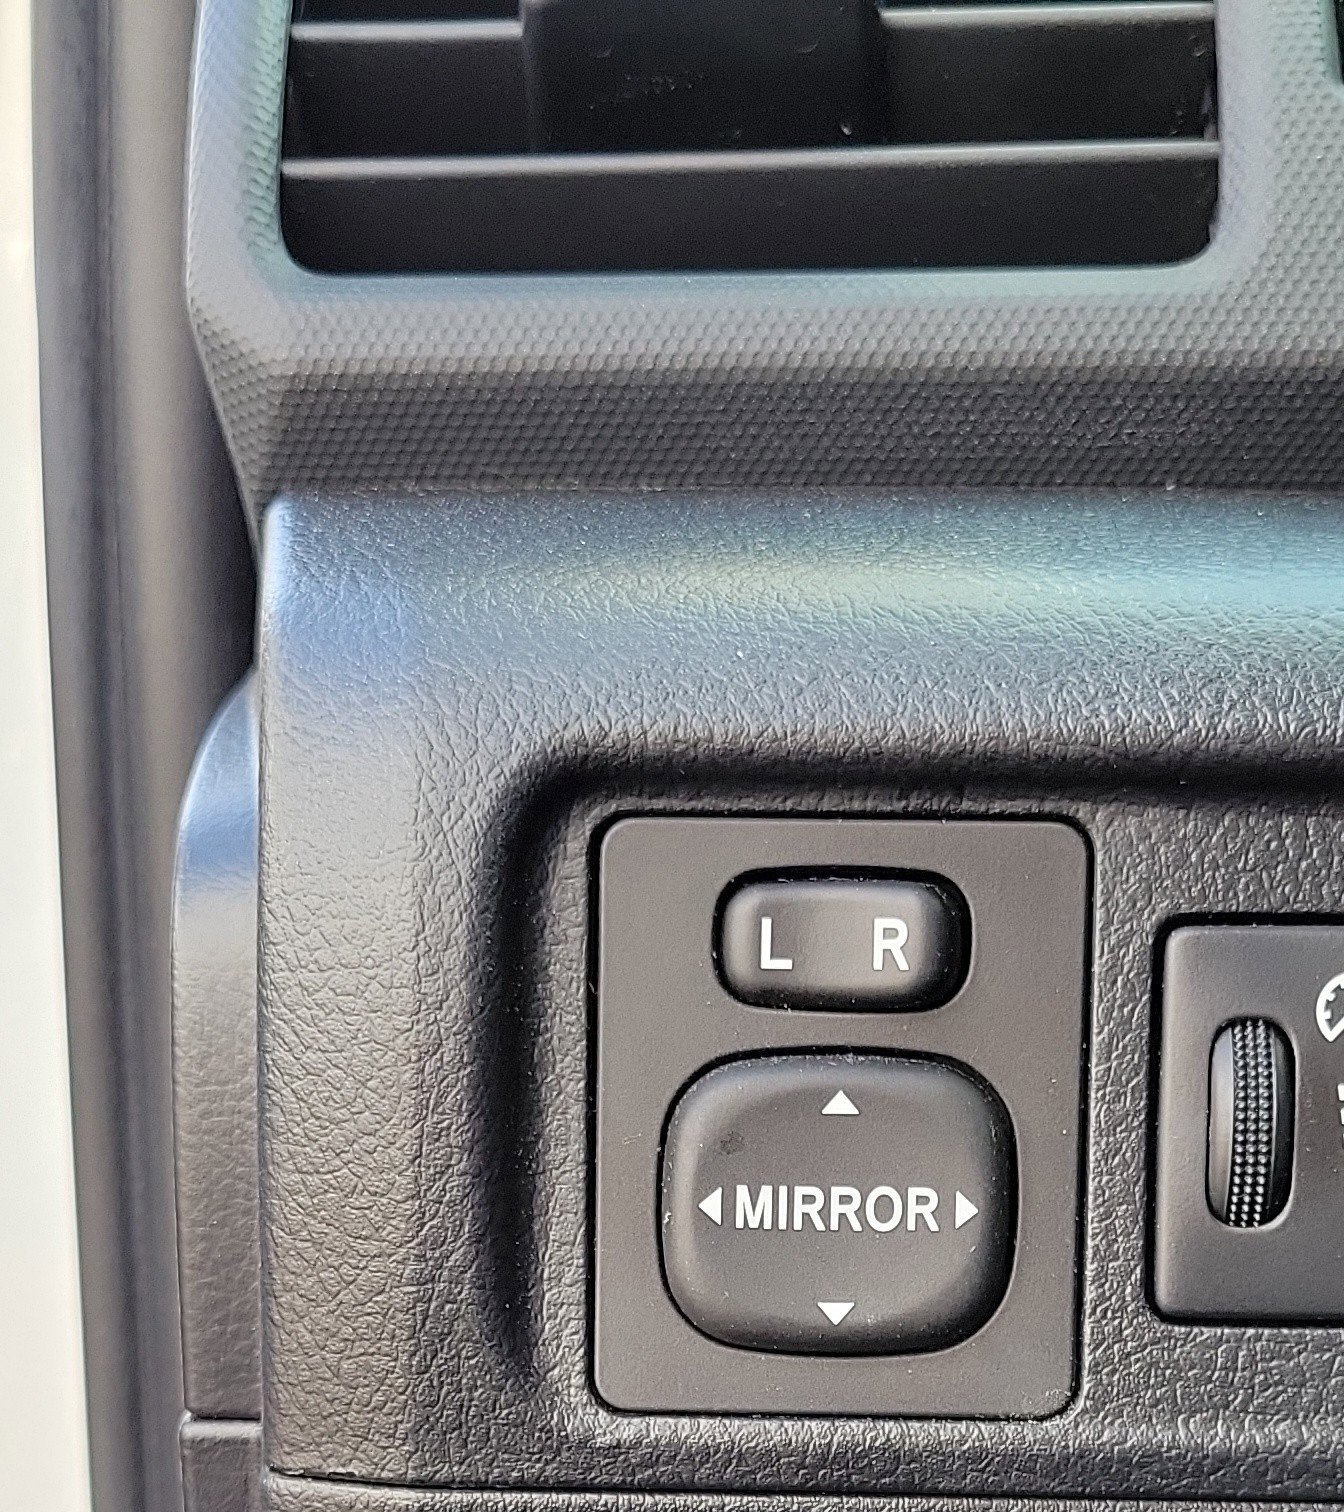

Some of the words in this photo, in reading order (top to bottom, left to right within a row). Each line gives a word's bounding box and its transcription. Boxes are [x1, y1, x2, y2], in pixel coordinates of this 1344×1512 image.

[759, 916, 794, 970] L
[871, 917, 911, 971] R
[733, 1184, 941, 1233] MIRROR
